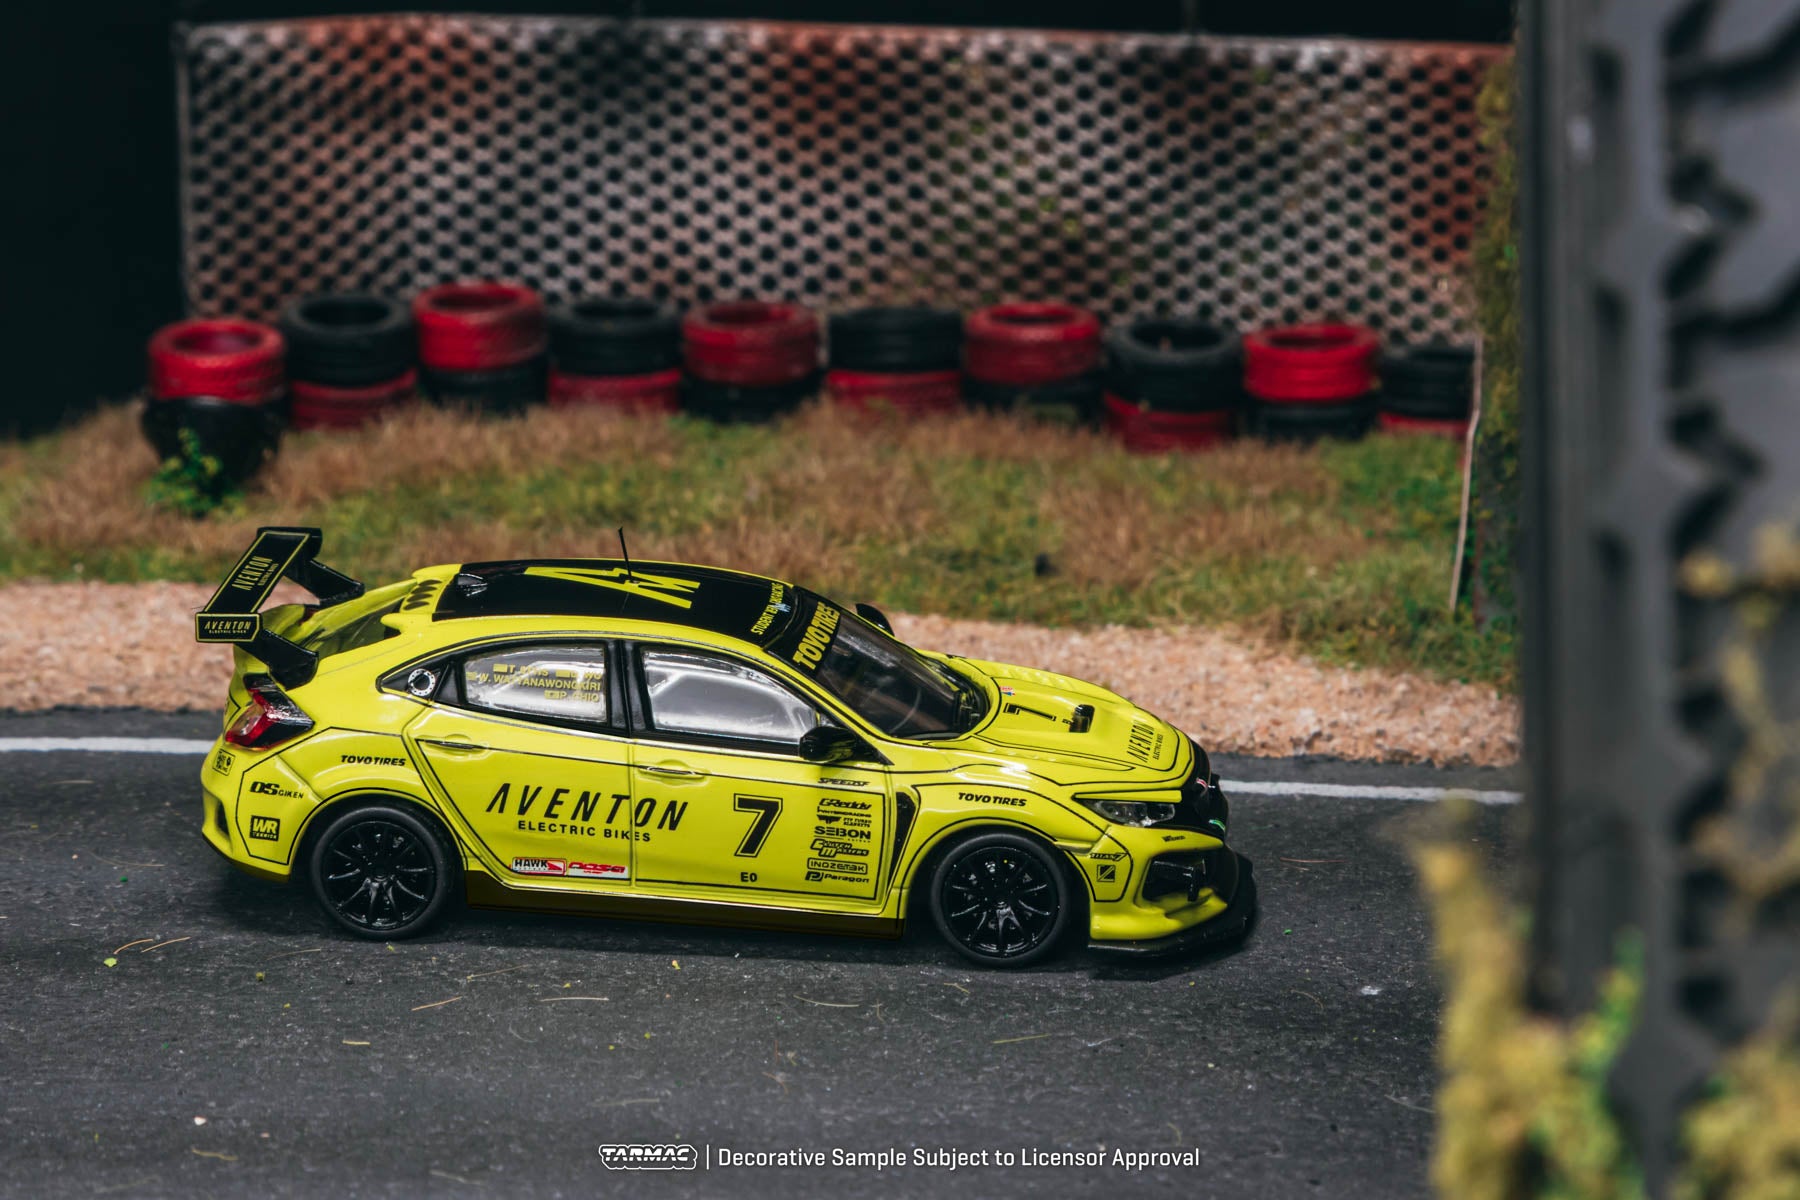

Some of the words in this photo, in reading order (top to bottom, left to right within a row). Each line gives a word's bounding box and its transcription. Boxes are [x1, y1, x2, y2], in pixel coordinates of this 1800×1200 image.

[204, 621, 252, 630] AVENTON
[793, 626, 831, 670] TOYO
[1126, 719, 1155, 763] AVENTON
[341, 754, 373, 765] TOYO
[373, 756, 406, 767] TIRES
[249, 781, 280, 796] OS
[278, 789, 304, 799] GIKEN
[486, 783, 688, 831] AVENTON
[958, 791, 992, 804] TOYO
[992, 795, 1027, 808] TIRES
[252, 818, 278, 834] WR
[517, 820, 596, 837] ELECTRIC
[603, 828, 652, 842] BIKES
[733, 792, 784, 858] 7
[513, 858, 548, 869] HAWK
[824, 873, 870, 883] Paragon
